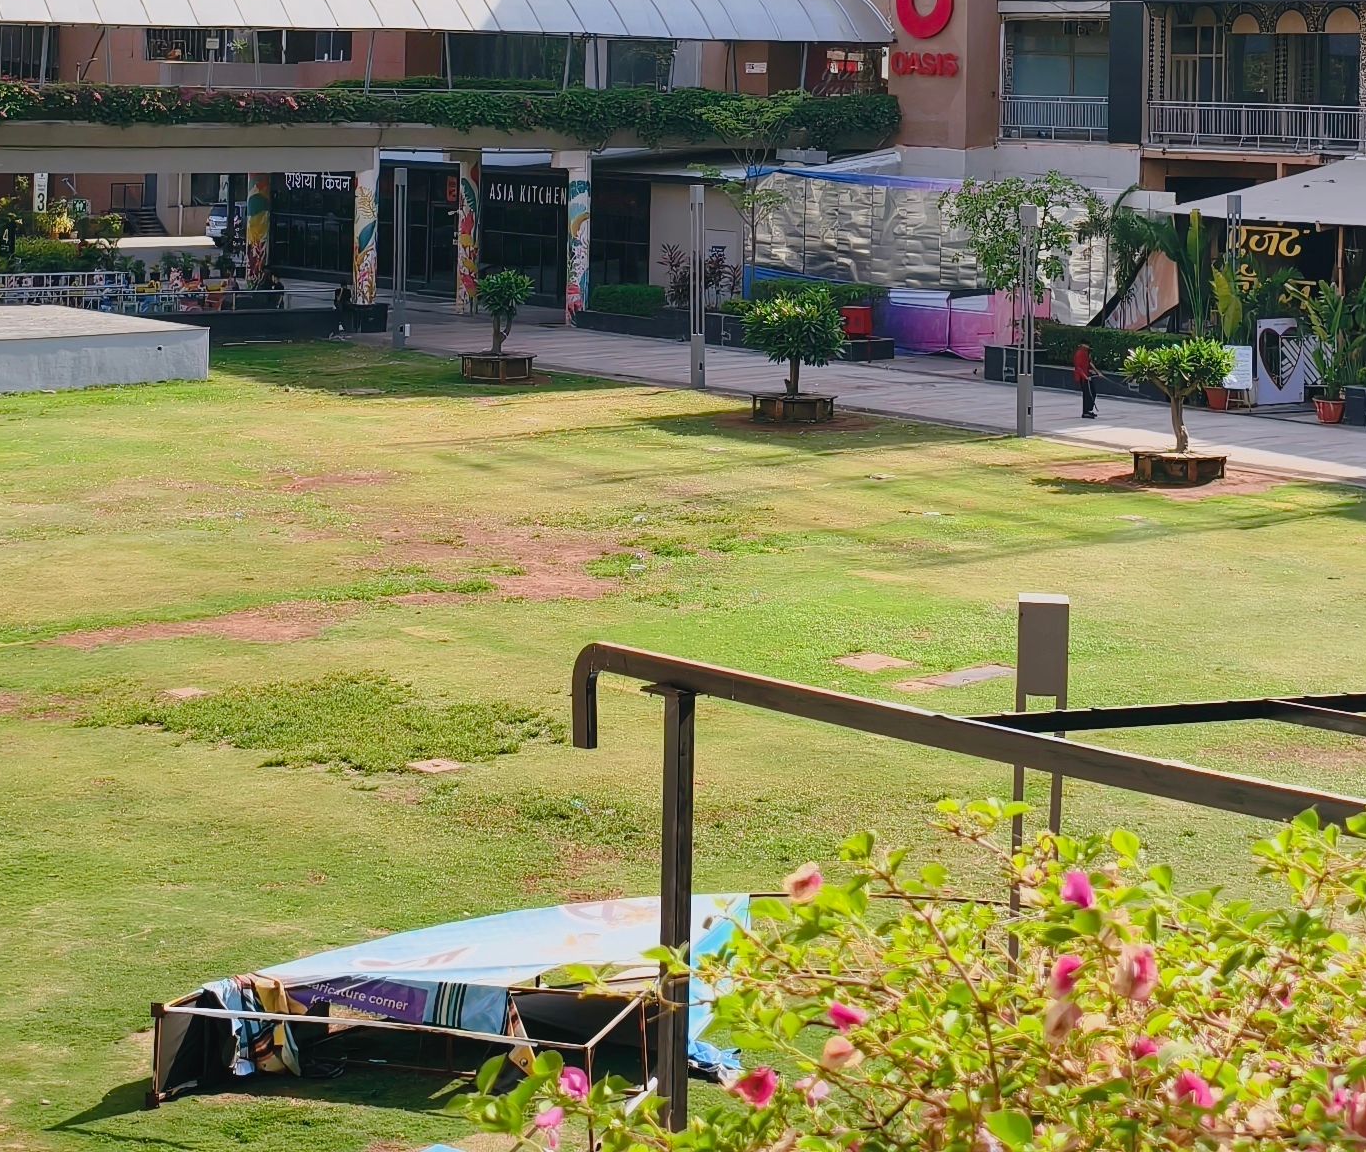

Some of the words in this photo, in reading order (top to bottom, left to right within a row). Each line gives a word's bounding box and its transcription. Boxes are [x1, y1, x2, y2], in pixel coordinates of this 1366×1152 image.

[890, 51, 959, 77] OASIS
[37, 192, 45, 212] 3
[489, 183, 514, 202] ASIA
[519, 184, 567, 206] KITCHEN
[2, 228, 9, 244] 4
[368, 994, 409, 1011] corner
